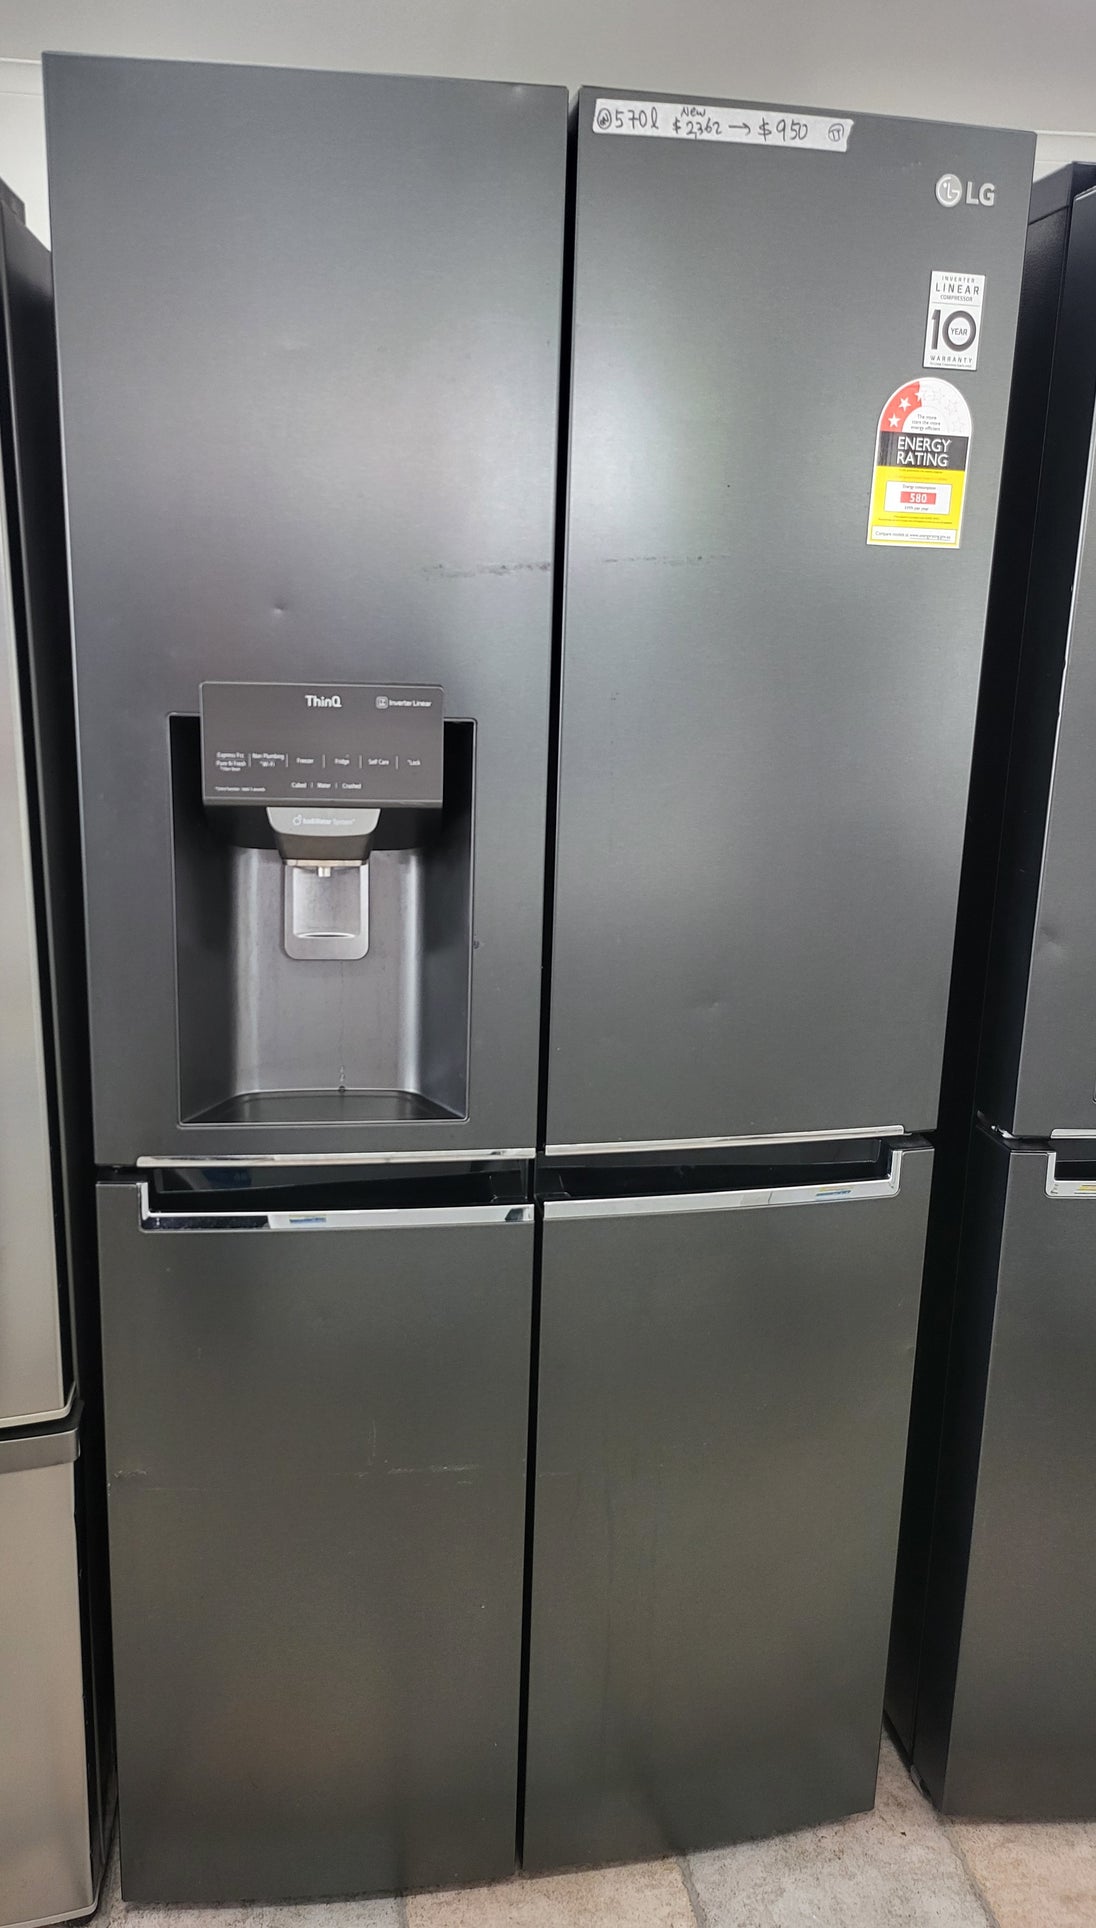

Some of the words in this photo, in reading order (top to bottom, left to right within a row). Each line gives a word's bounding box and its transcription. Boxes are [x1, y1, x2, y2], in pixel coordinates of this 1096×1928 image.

[680, 106, 706, 118] New
[757, 116, 809, 142] $950
[966, 181, 995, 207] LG
[941, 275, 975, 284] INVERTER
[935, 282, 980, 296] LINEAR
[931, 308, 977, 352] 10
[950, 327, 968, 337] YEAR
[929, 355, 973, 363] WARRANTY
[897, 436, 952, 453] ENERGY
[896, 452, 949, 467] RATING
[909, 493, 928, 504] 580
[305, 694, 342, 708] ThinQ
[389, 699, 412, 707] Inverter
